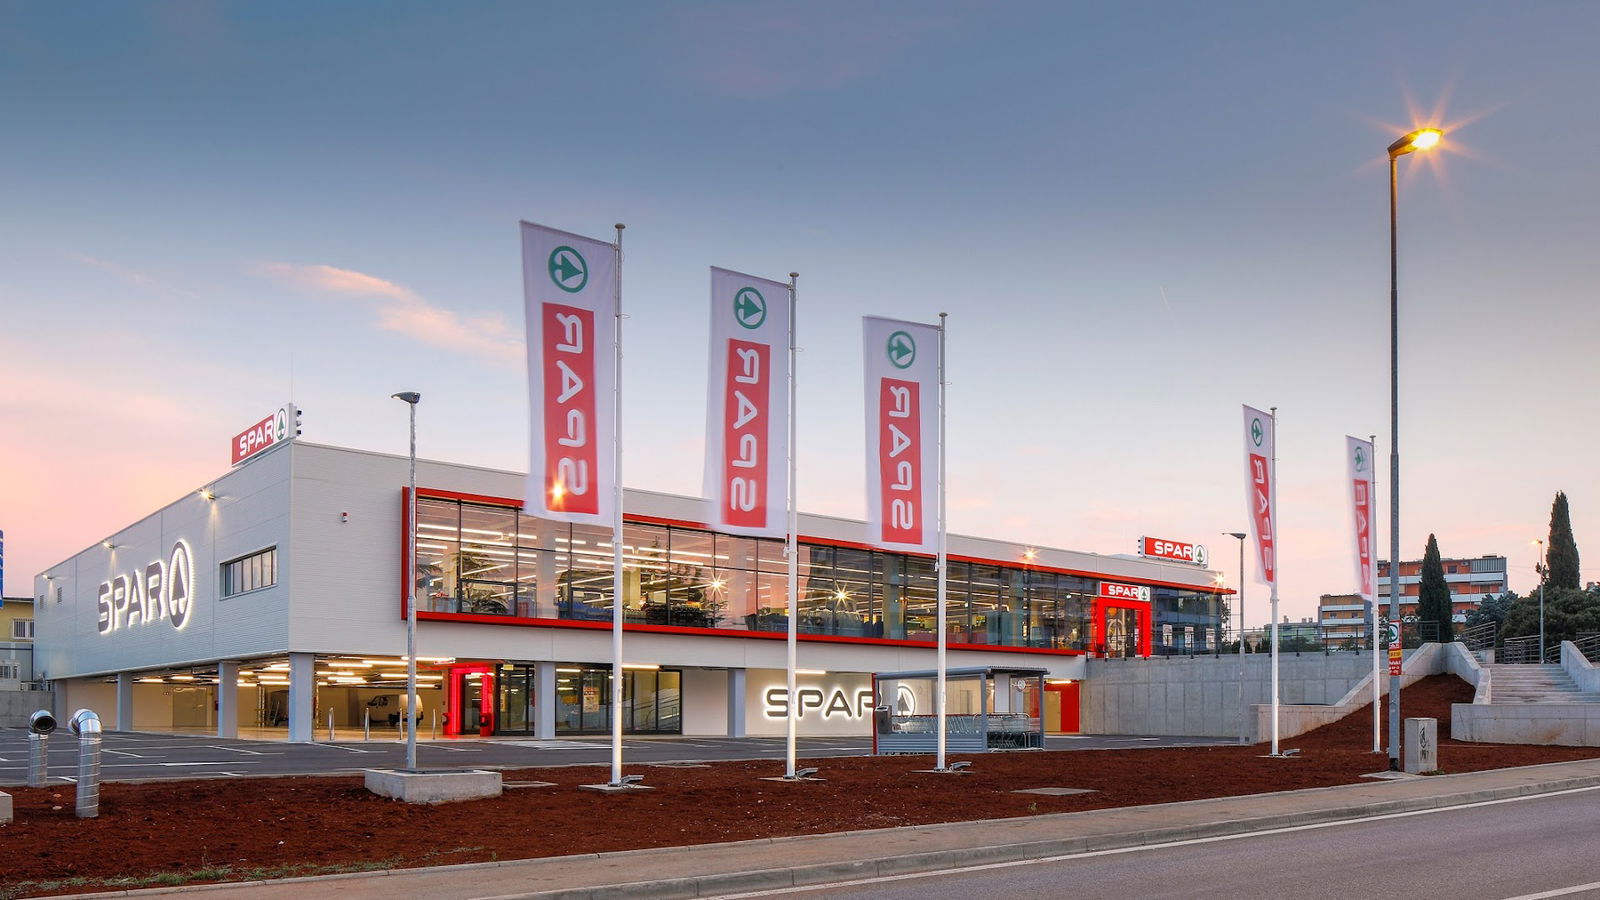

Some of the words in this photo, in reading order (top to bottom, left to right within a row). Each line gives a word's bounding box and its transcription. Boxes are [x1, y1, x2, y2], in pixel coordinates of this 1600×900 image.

[240, 420, 273, 456] SPAR
[1154, 541, 1192, 559] SPAR
[97, 560, 164, 634] SPAR
[1108, 585, 1139, 598] SPAR
